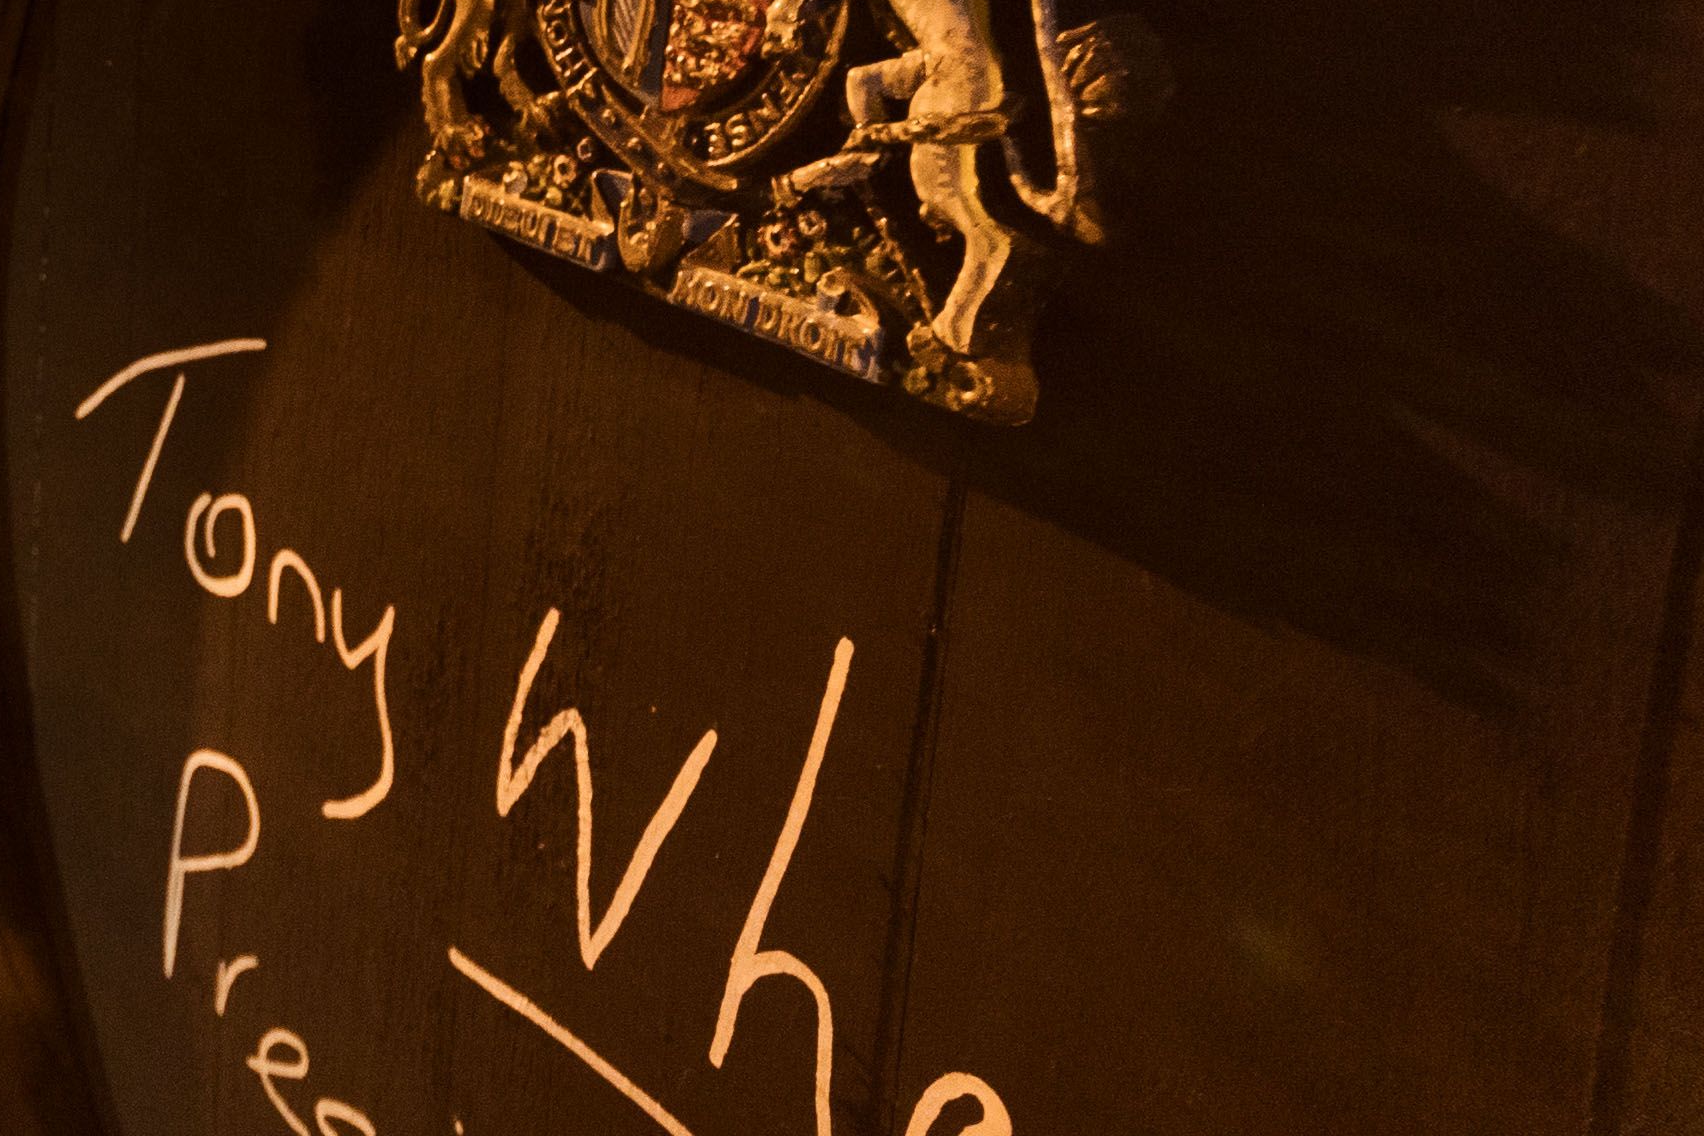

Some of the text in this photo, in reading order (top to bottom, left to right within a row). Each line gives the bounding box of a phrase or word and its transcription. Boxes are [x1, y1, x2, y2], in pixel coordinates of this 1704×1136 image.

[669, 269, 873, 373] MON DROIT
[74, 337, 397, 821] Tony
